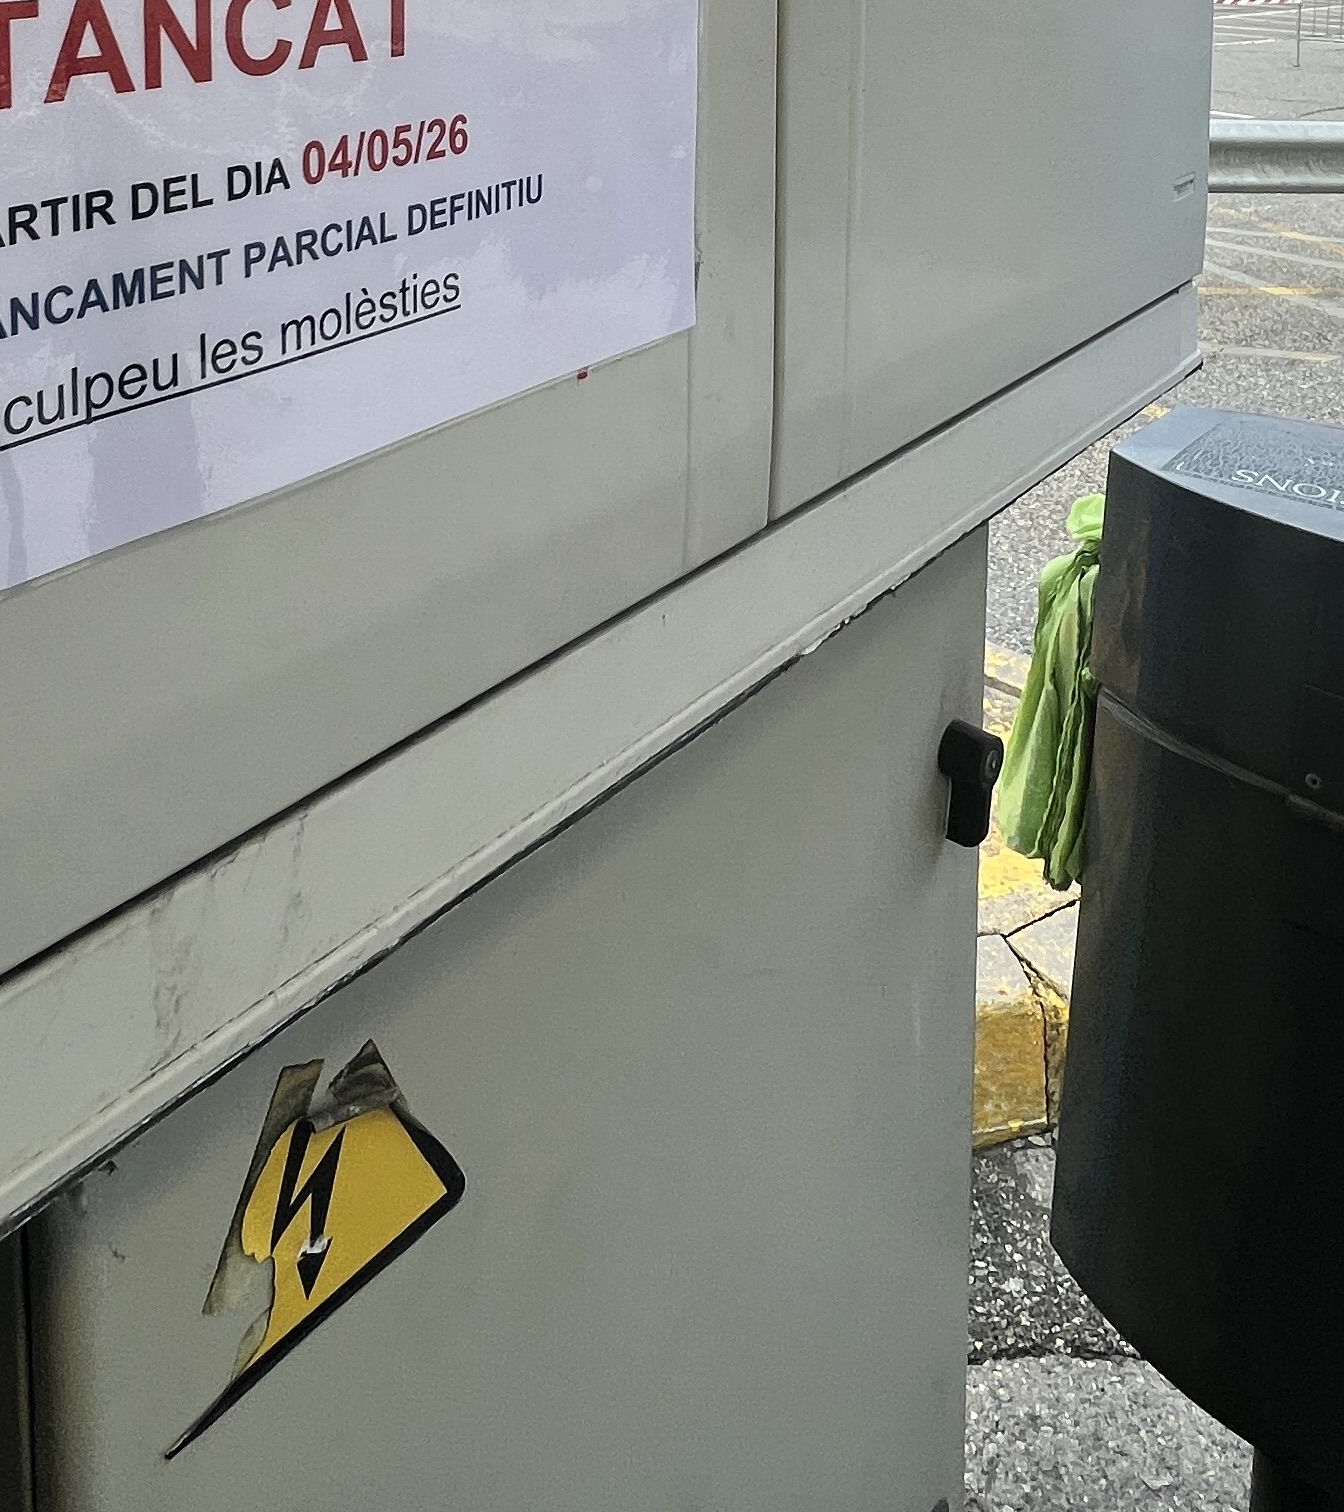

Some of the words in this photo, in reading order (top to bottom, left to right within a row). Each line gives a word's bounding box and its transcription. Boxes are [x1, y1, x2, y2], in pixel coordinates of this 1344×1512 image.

[131, 173, 214, 220] DEL
[227, 157, 291, 202] DIA
[302, 113, 469, 185] 04/05/26
[244, 211, 398, 279] PARCIAL
[407, 173, 544, 236] DEFINITIU
[199, 329, 264, 380] les
[279, 270, 461, 356] molèsties
